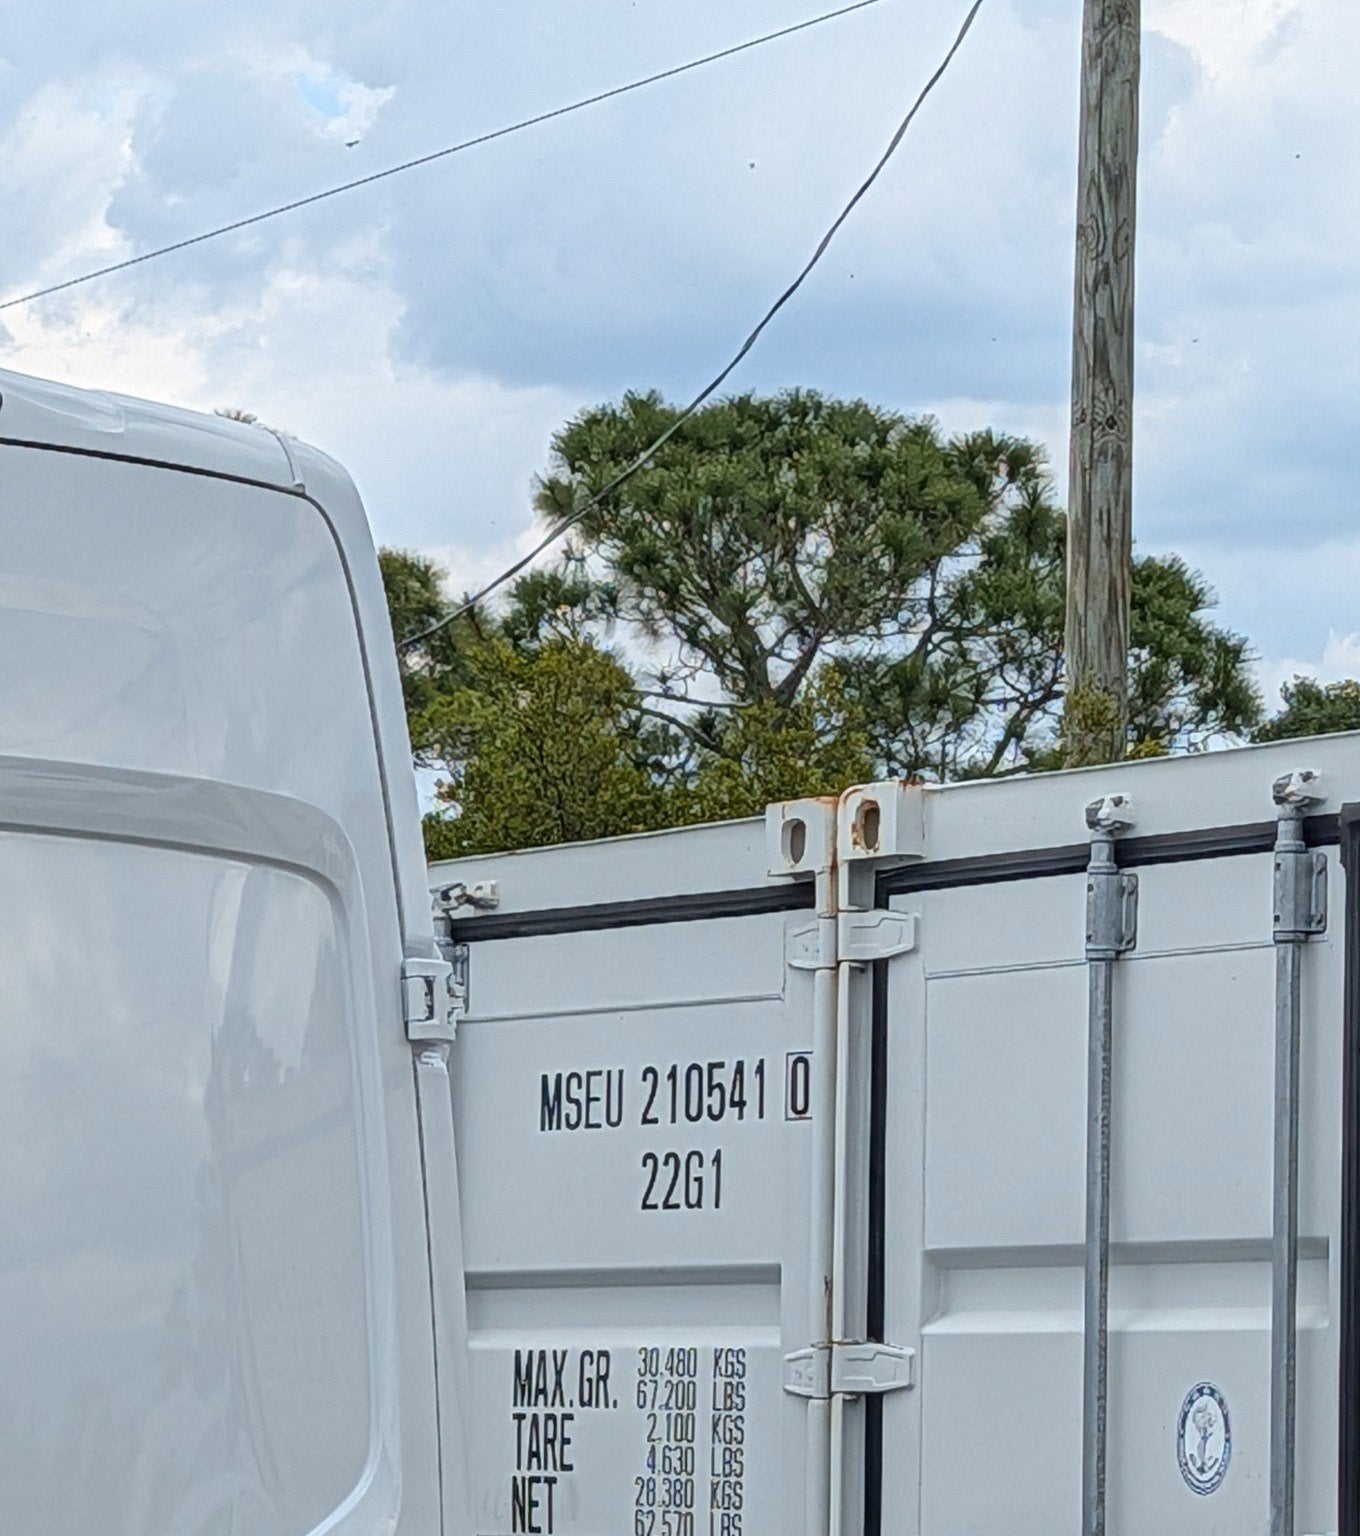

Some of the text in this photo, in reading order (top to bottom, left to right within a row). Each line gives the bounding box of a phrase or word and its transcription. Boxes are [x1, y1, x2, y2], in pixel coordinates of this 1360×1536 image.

[539, 1055, 811, 1132] MSEU 210541 0
[640, 1148, 723, 1211] 22G1
[512, 1347, 747, 1409] MAX.GR. 30.480 KGS
[636, 1379, 746, 1412] 67.200 LBS
[512, 1412, 745, 1472] TARE 2.100 KGS
[646, 1445, 745, 1478] 4.630 LBS
[511, 1475, 744, 1535] NET 28.380 KGS
